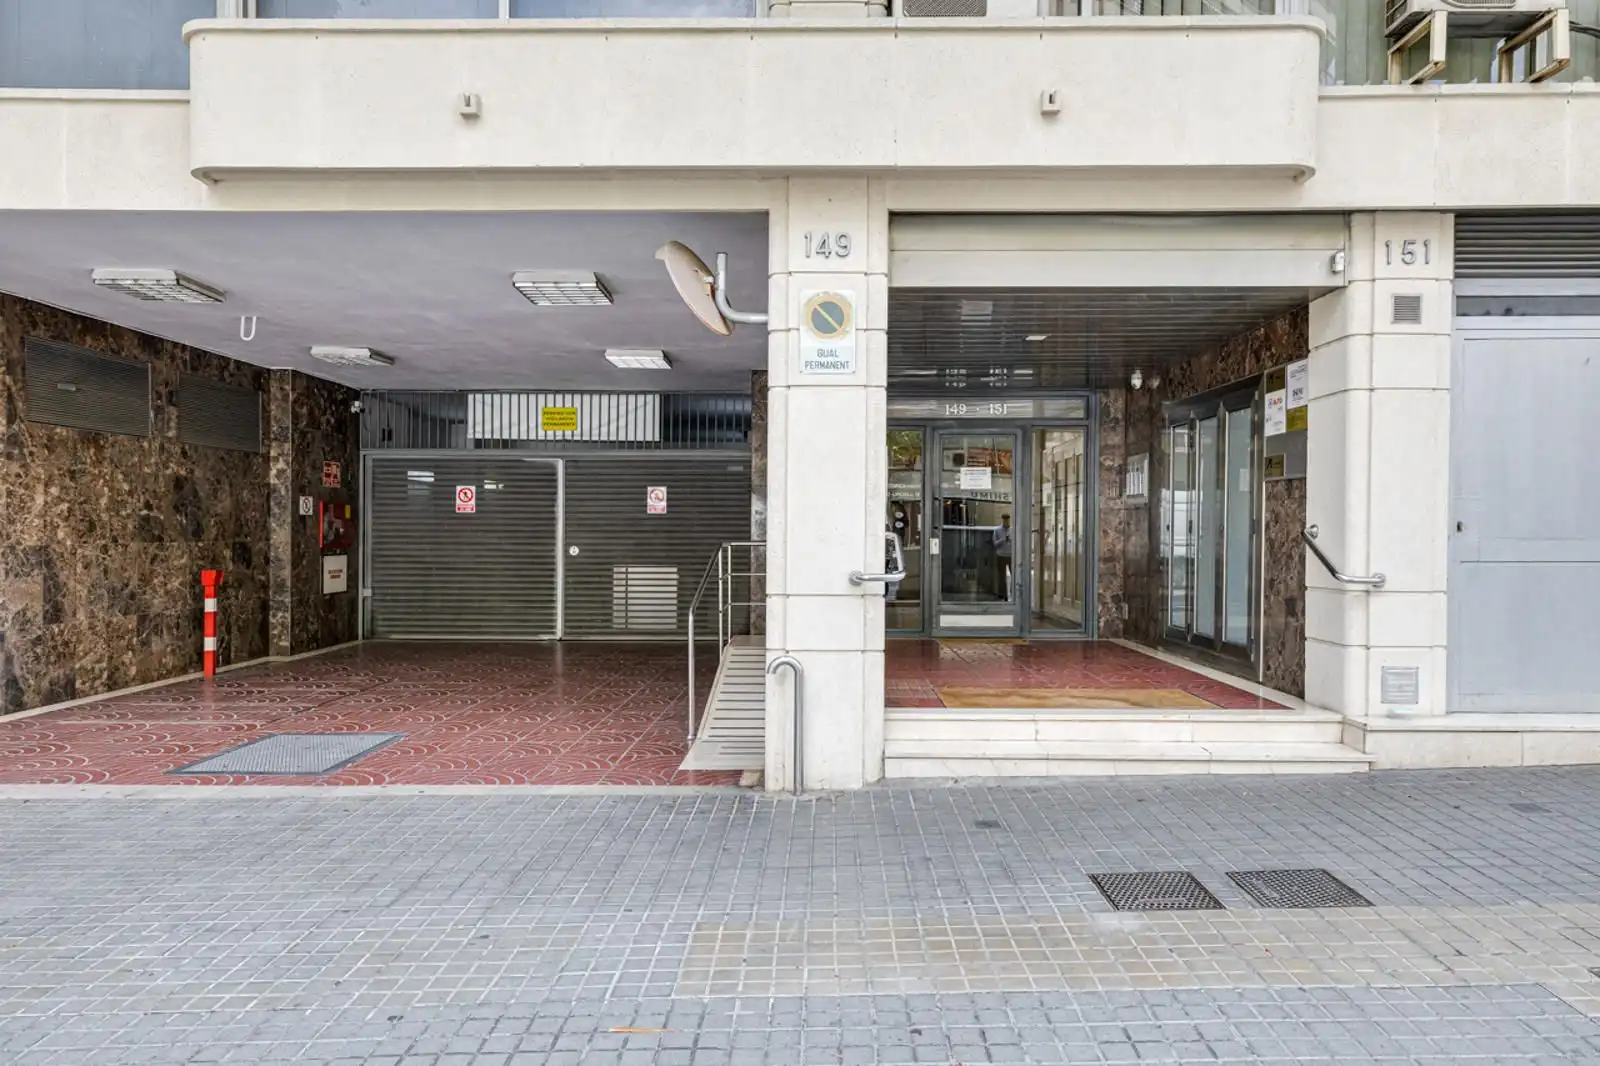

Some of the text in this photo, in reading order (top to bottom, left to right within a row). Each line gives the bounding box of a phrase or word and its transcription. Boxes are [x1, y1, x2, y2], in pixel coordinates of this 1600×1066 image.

[804, 231, 852, 259] 149
[1385, 239, 1431, 265] 151
[816, 348, 840, 358] GUAL
[804, 360, 850, 370] PERMANENT
[945, 403, 968, 416] 149
[990, 403, 1008, 415] 151
